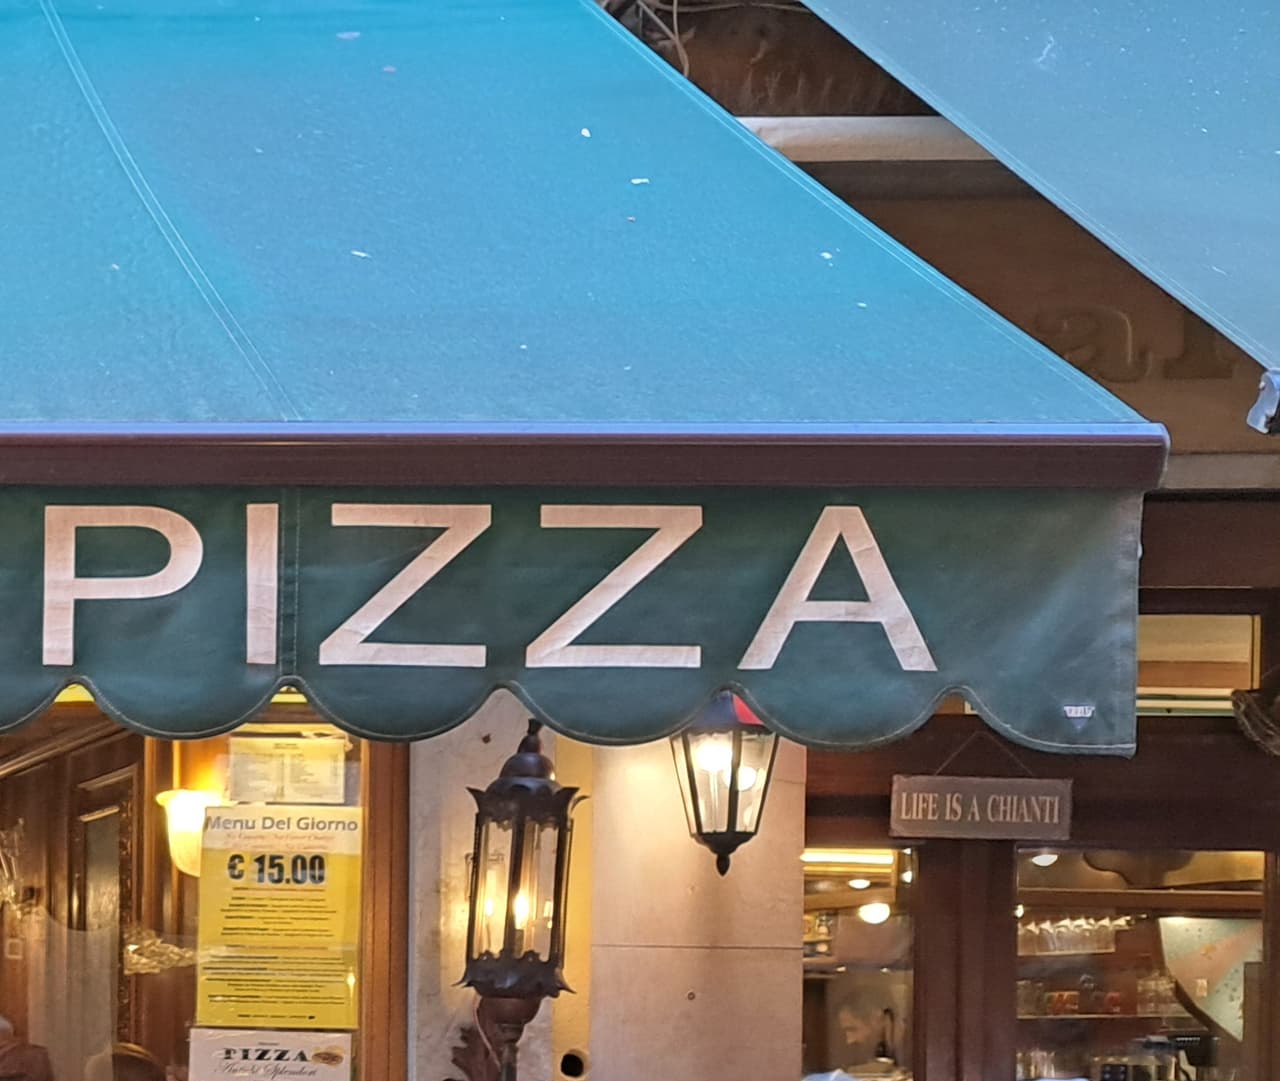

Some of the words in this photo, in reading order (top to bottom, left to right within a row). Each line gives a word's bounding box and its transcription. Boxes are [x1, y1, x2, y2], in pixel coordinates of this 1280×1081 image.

[40, 502, 939, 672] PIZZA
[205, 816, 256, 831] Menu
[261, 816, 291, 831] Del
[296, 817, 359, 832] Giorno
[900, 792, 940, 821] LIFE
[945, 793, 963, 821] IS
[967, 795, 981, 822] A
[986, 794, 1060, 824] CHIANTI
[227, 853, 245, 880] €
[253, 854, 326, 885] 15.00
[222, 1047, 311, 1063] PIZZA
